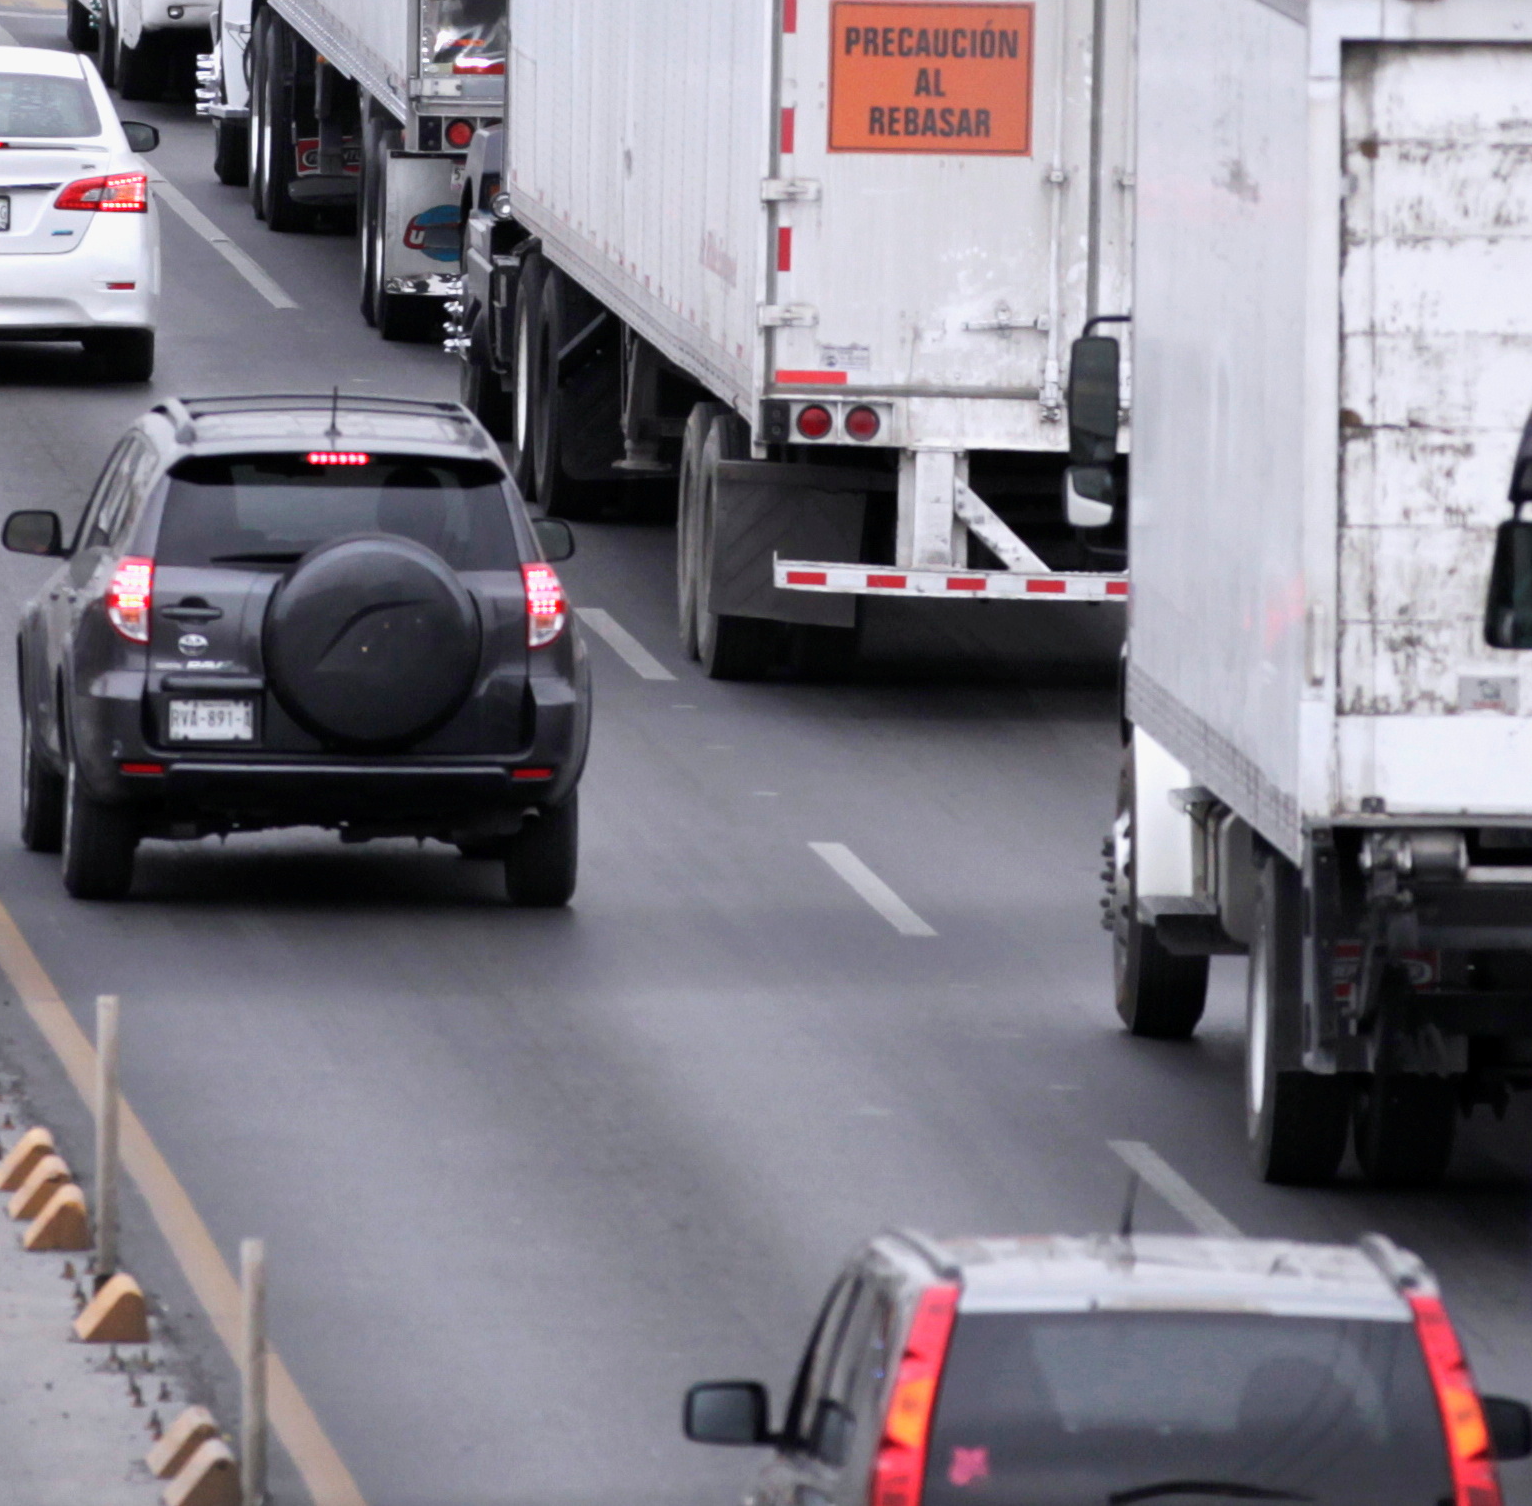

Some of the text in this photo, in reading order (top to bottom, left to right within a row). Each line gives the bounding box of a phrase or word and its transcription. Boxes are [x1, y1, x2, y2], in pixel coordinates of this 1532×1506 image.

[844, 19, 1019, 58] PRECAUCIÓN
[914, 68, 946, 98] AL
[868, 106, 992, 138] REBASAR
